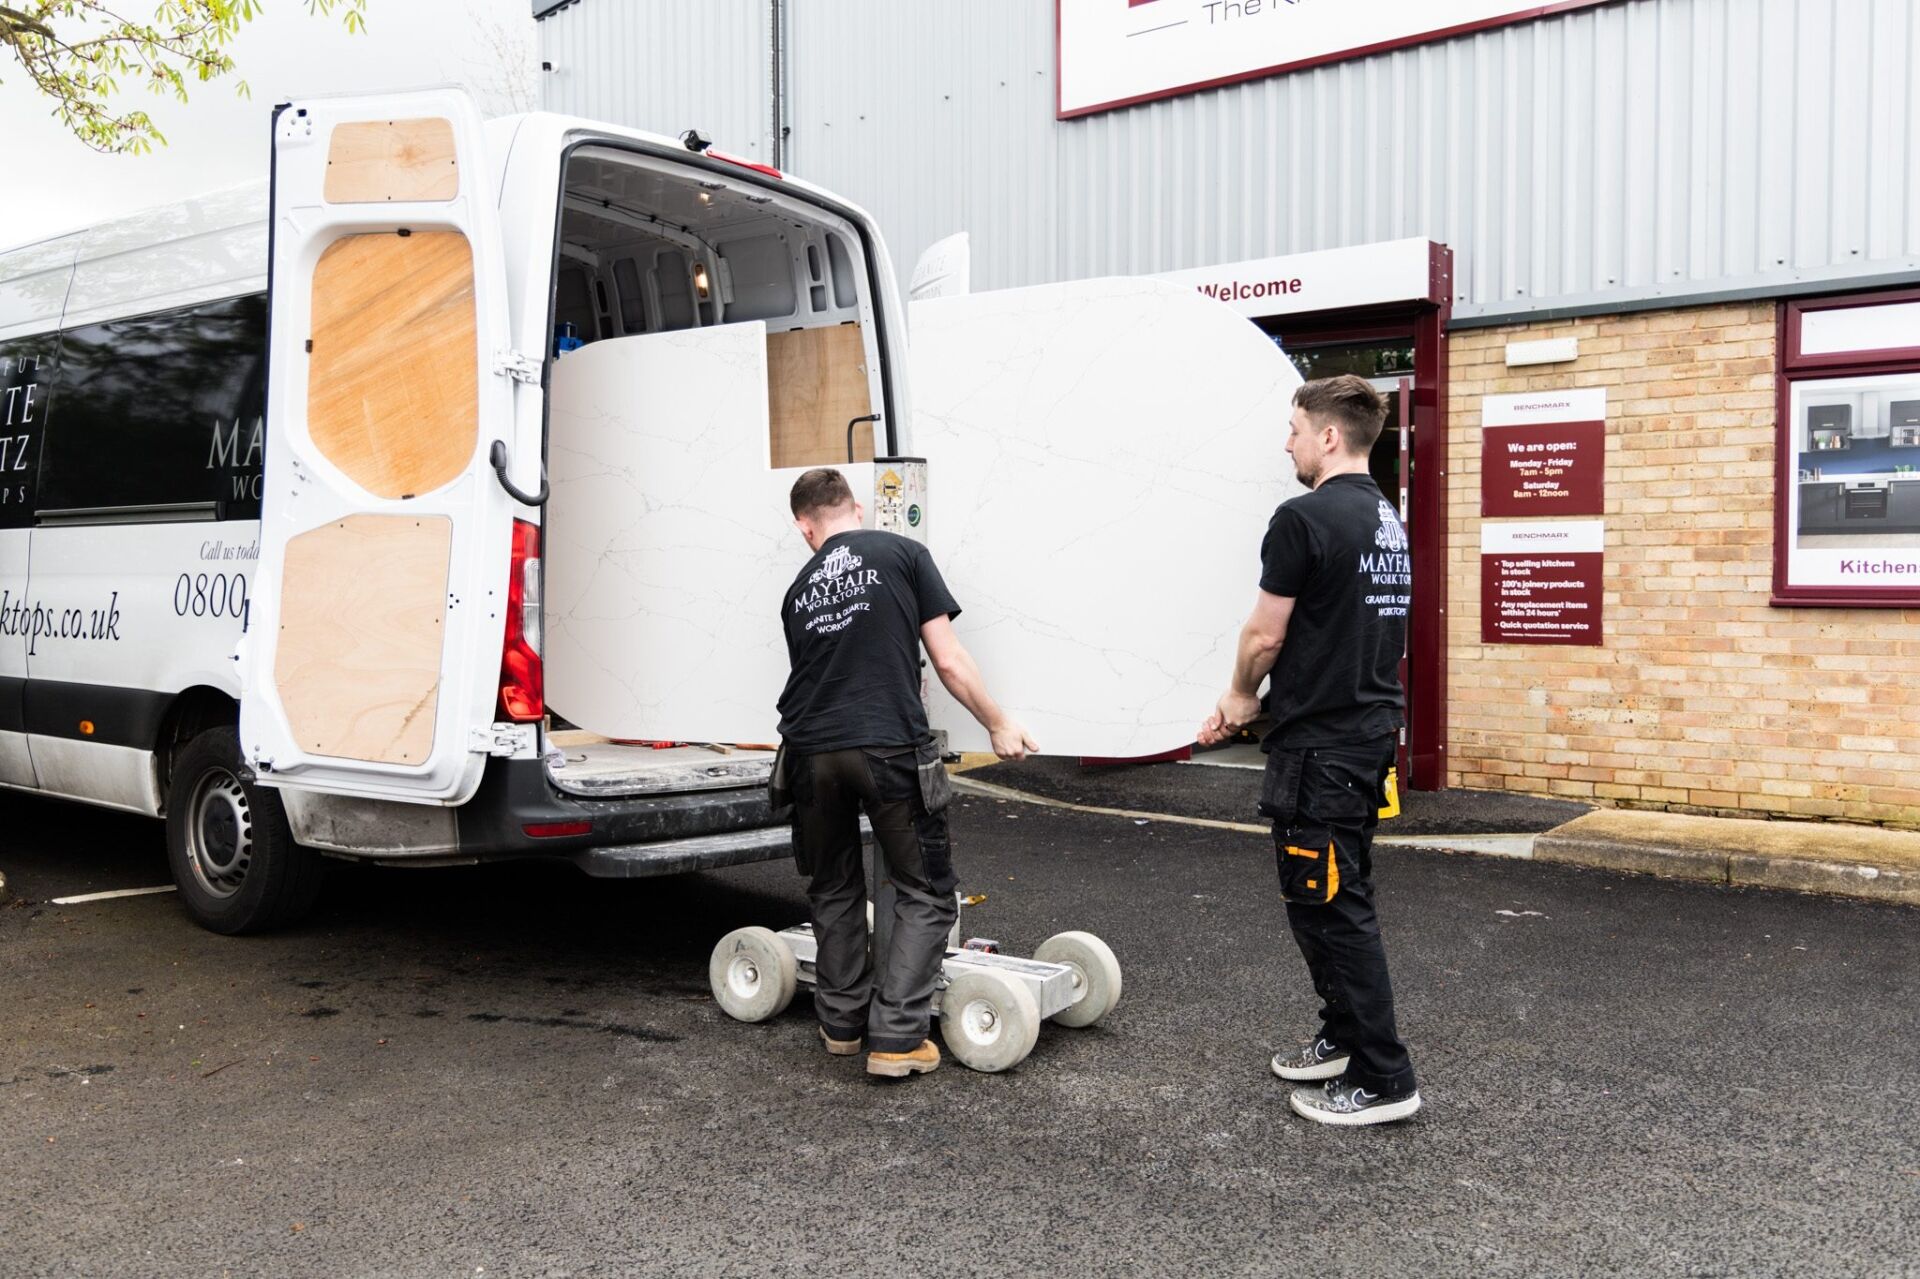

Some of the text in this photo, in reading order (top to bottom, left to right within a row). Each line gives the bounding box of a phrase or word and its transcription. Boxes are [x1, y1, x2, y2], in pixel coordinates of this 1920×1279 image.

[1202, 0, 1261, 24] The
[1197, 279, 1302, 301] Welcome
[0, 383, 38, 426] TE
[1513, 402, 1571, 411] BENCHMARX
[1507, 441, 1577, 453] We are open:
[1509, 460, 1542, 469] Monday
[1547, 458, 1574, 468] Friday
[1520, 468, 1538, 476] 7am
[1544, 467, 1563, 477] 5pm
[1523, 481, 1560, 491] Saturday
[1513, 490, 1532, 498] 8am
[1538, 489, 1569, 498] 12noon
[200, 540, 222, 560] Call
[223, 547, 235, 560] us
[1501, 560, 1576, 569] Top selling kitchens
[1840, 560, 1920, 574] Kitchen
[1510, 568, 1531, 576] stock
[1522, 580, 1549, 590] joinery
[1549, 580, 1585, 590] products
[174, 573, 247, 618] 0800
[794, 569, 883, 613] MAYFAIR
[1509, 588, 1531, 596] stock
[806, 585, 866, 613] WORKTOPS
[1501, 601, 1588, 609] Any replacement items
[805, 602, 871, 630] GRANITE & QUARTZ
[1501, 609, 1525, 617] within
[1526, 609, 1537, 617] 24
[0, 590, 120, 656] ktops.co.uk
[1500, 621, 1590, 630] Quick quotation service
